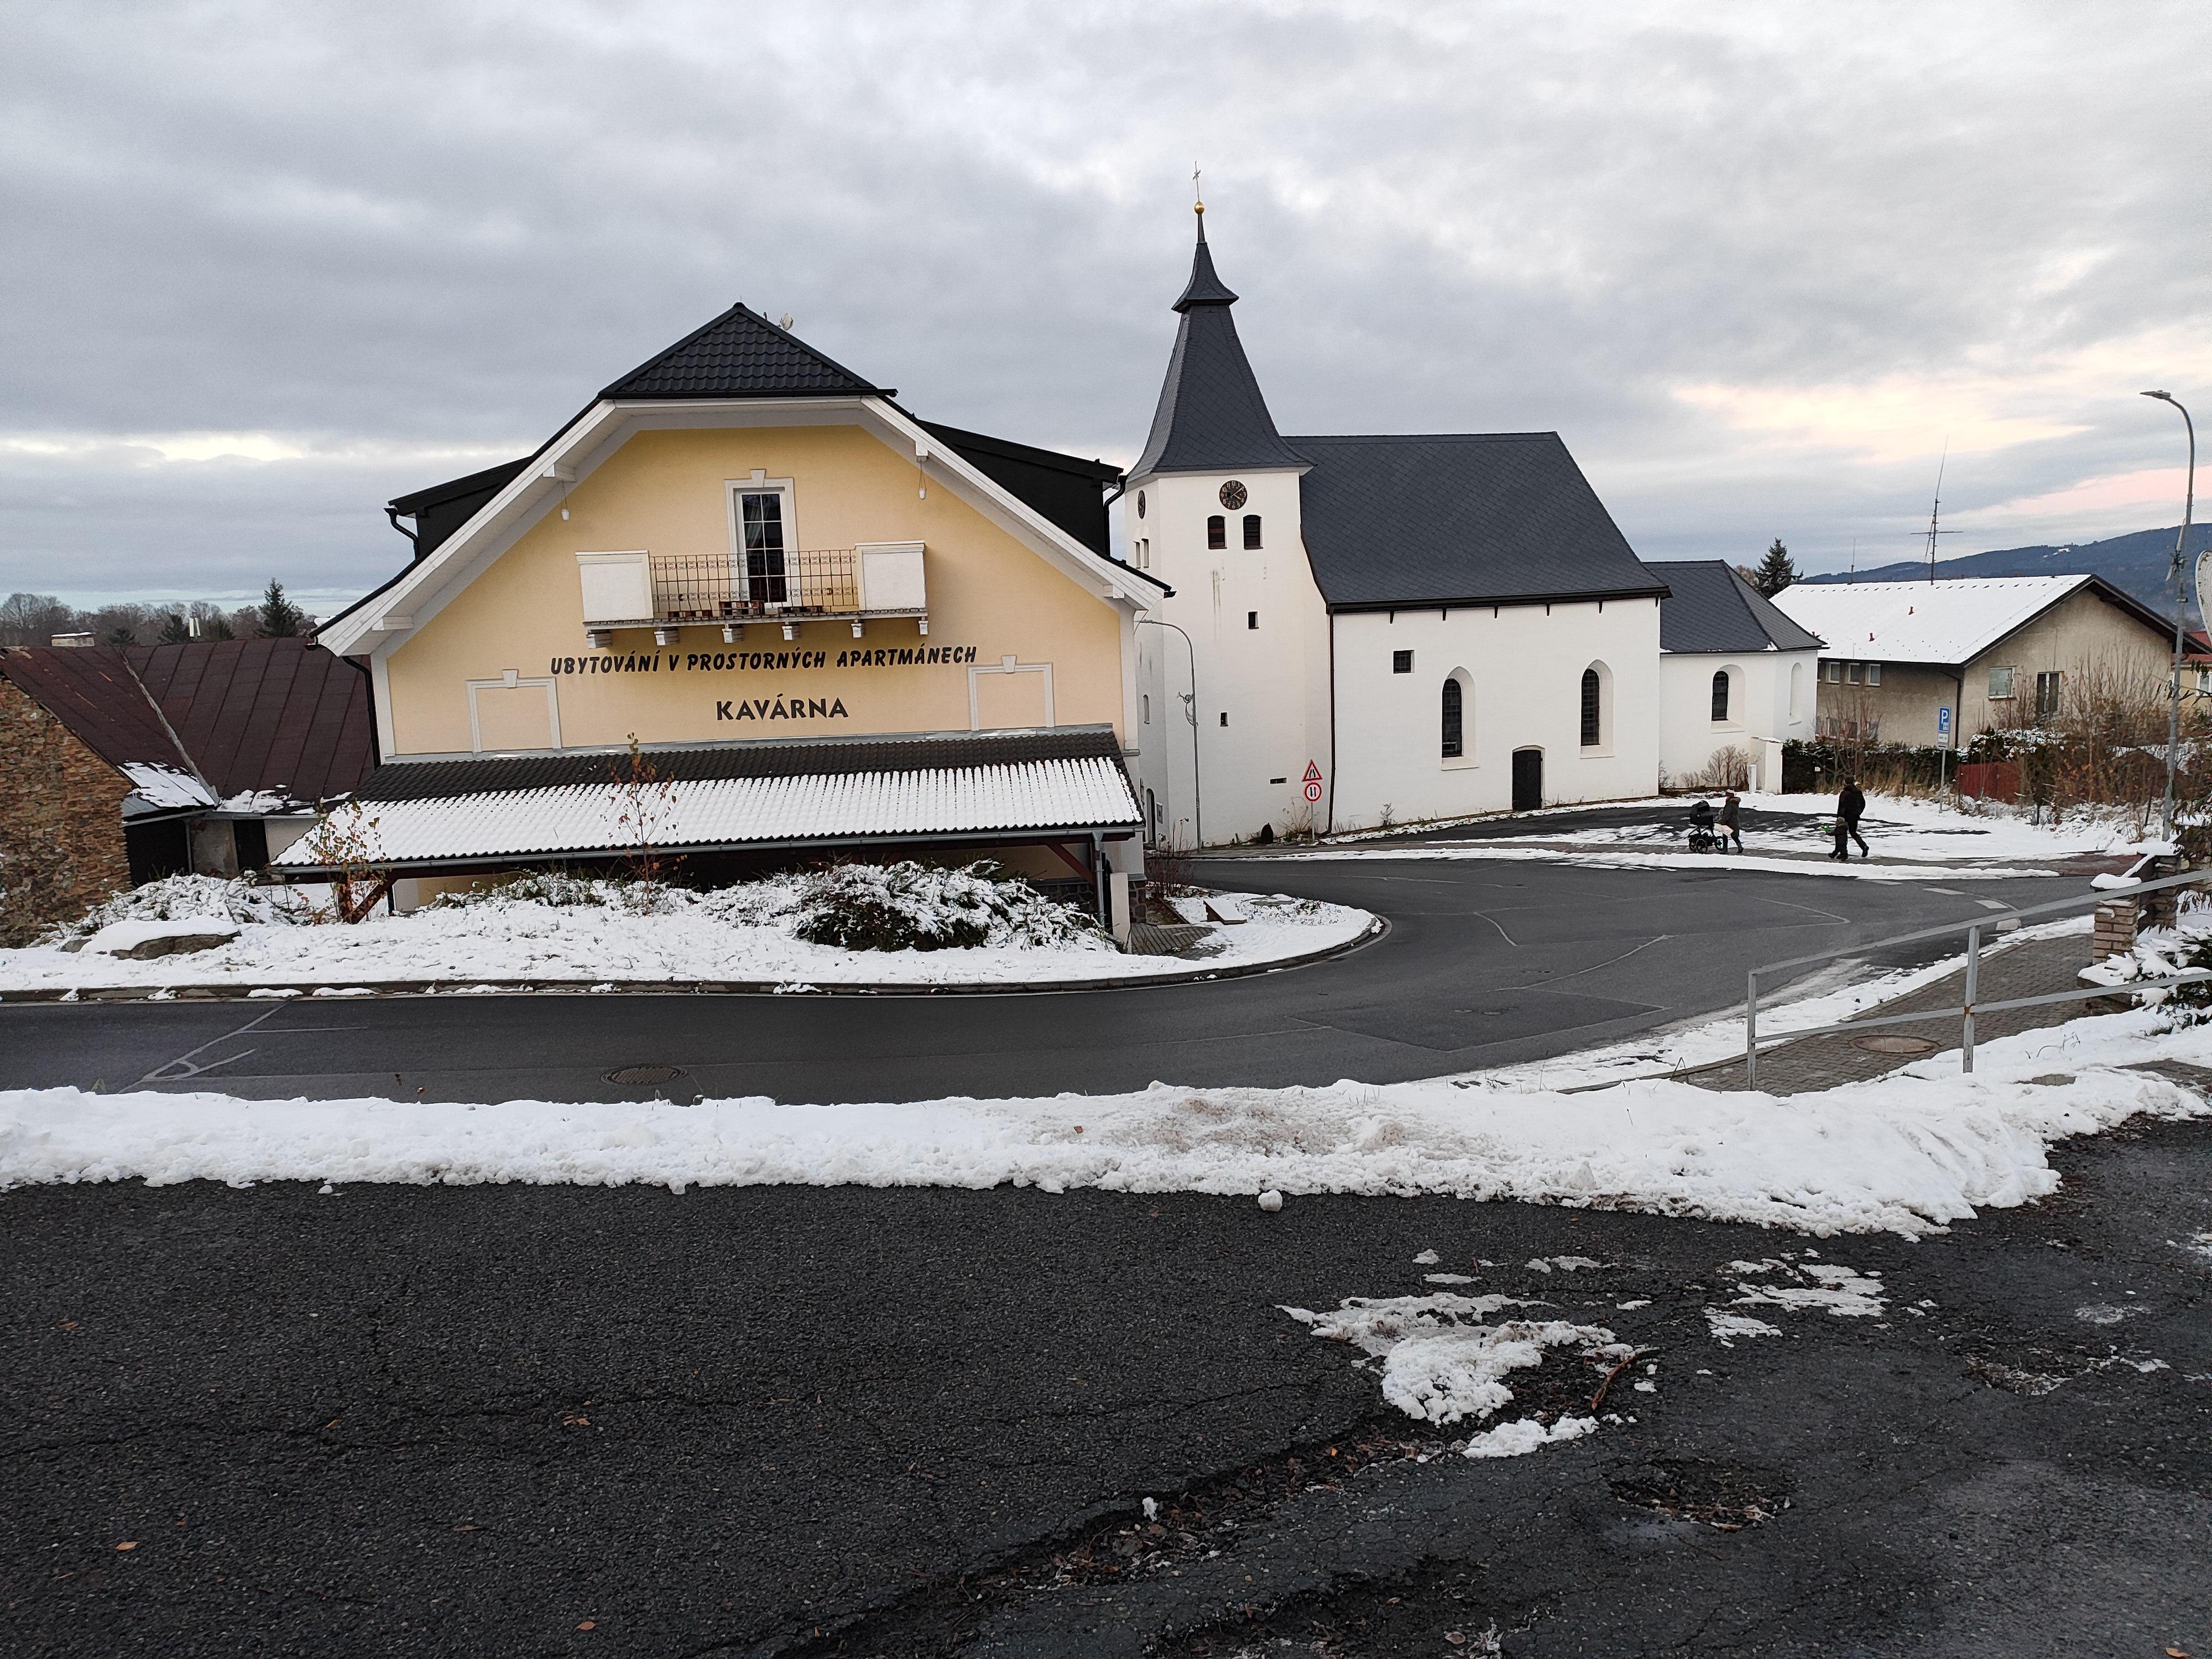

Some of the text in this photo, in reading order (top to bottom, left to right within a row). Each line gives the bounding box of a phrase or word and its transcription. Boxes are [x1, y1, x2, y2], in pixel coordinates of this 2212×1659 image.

[550, 643, 977, 675] UBYTOVÁNÍ V PROSTORNÝCH APARTMÁNECH
[716, 693, 849, 721] KAVÁRNA
[1942, 709, 1948, 724] P
